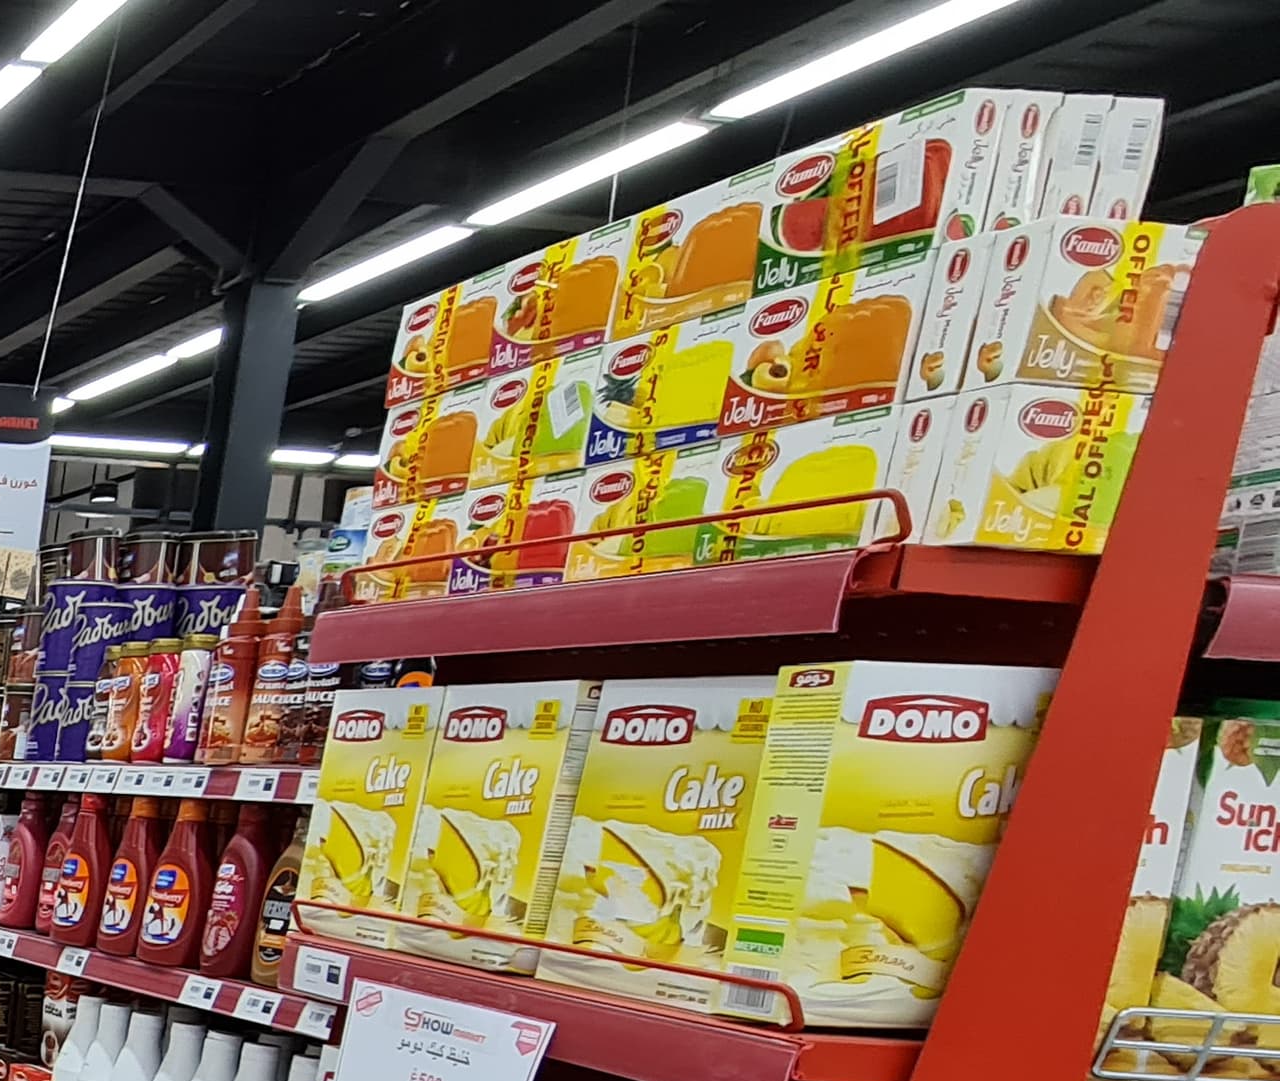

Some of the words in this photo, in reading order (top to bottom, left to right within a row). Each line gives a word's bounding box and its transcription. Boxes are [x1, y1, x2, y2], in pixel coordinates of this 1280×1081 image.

[780, 157, 833, 193] Family
[1064, 234, 1121, 264] Family
[756, 256, 798, 291] Jelly
[1115, 233, 1152, 325] OFFER
[753, 302, 805, 333] Family
[492, 344, 520, 371] Jelly
[612, 348, 650, 373] Family
[1027, 334, 1075, 378] Jelly
[388, 378, 413, 401] Jelly
[493, 385, 525, 406] Family
[723, 395, 766, 428] Jelly
[589, 432, 621, 458] Jelly
[10, 474, 38, 490] كورن
[592, 474, 634, 499] Family
[470, 498, 505, 520] Family
[985, 501, 1033, 543] Jelly
[373, 517, 403, 536] Family
[451, 568, 478, 592] Jelly
[793, 671, 832, 687] دومو
[335, 719, 382, 739] DOMO
[445, 717, 501, 739] DOMO
[606, 717, 690, 743] DOMO
[868, 708, 982, 740] DOMO
[366, 757, 411, 794] Cake
[482, 759, 540, 800] Cake
[664, 764, 745, 812] Cake
[383, 791, 405, 807] mix
[957, 766, 1021, 820] Cak
[505, 800, 532, 815] mix
[698, 808, 736, 830] mix
[1216, 791, 1277, 828] Sun
[854, 950, 917, 973] Banana
[404, 1007, 454, 1036] SHOW
